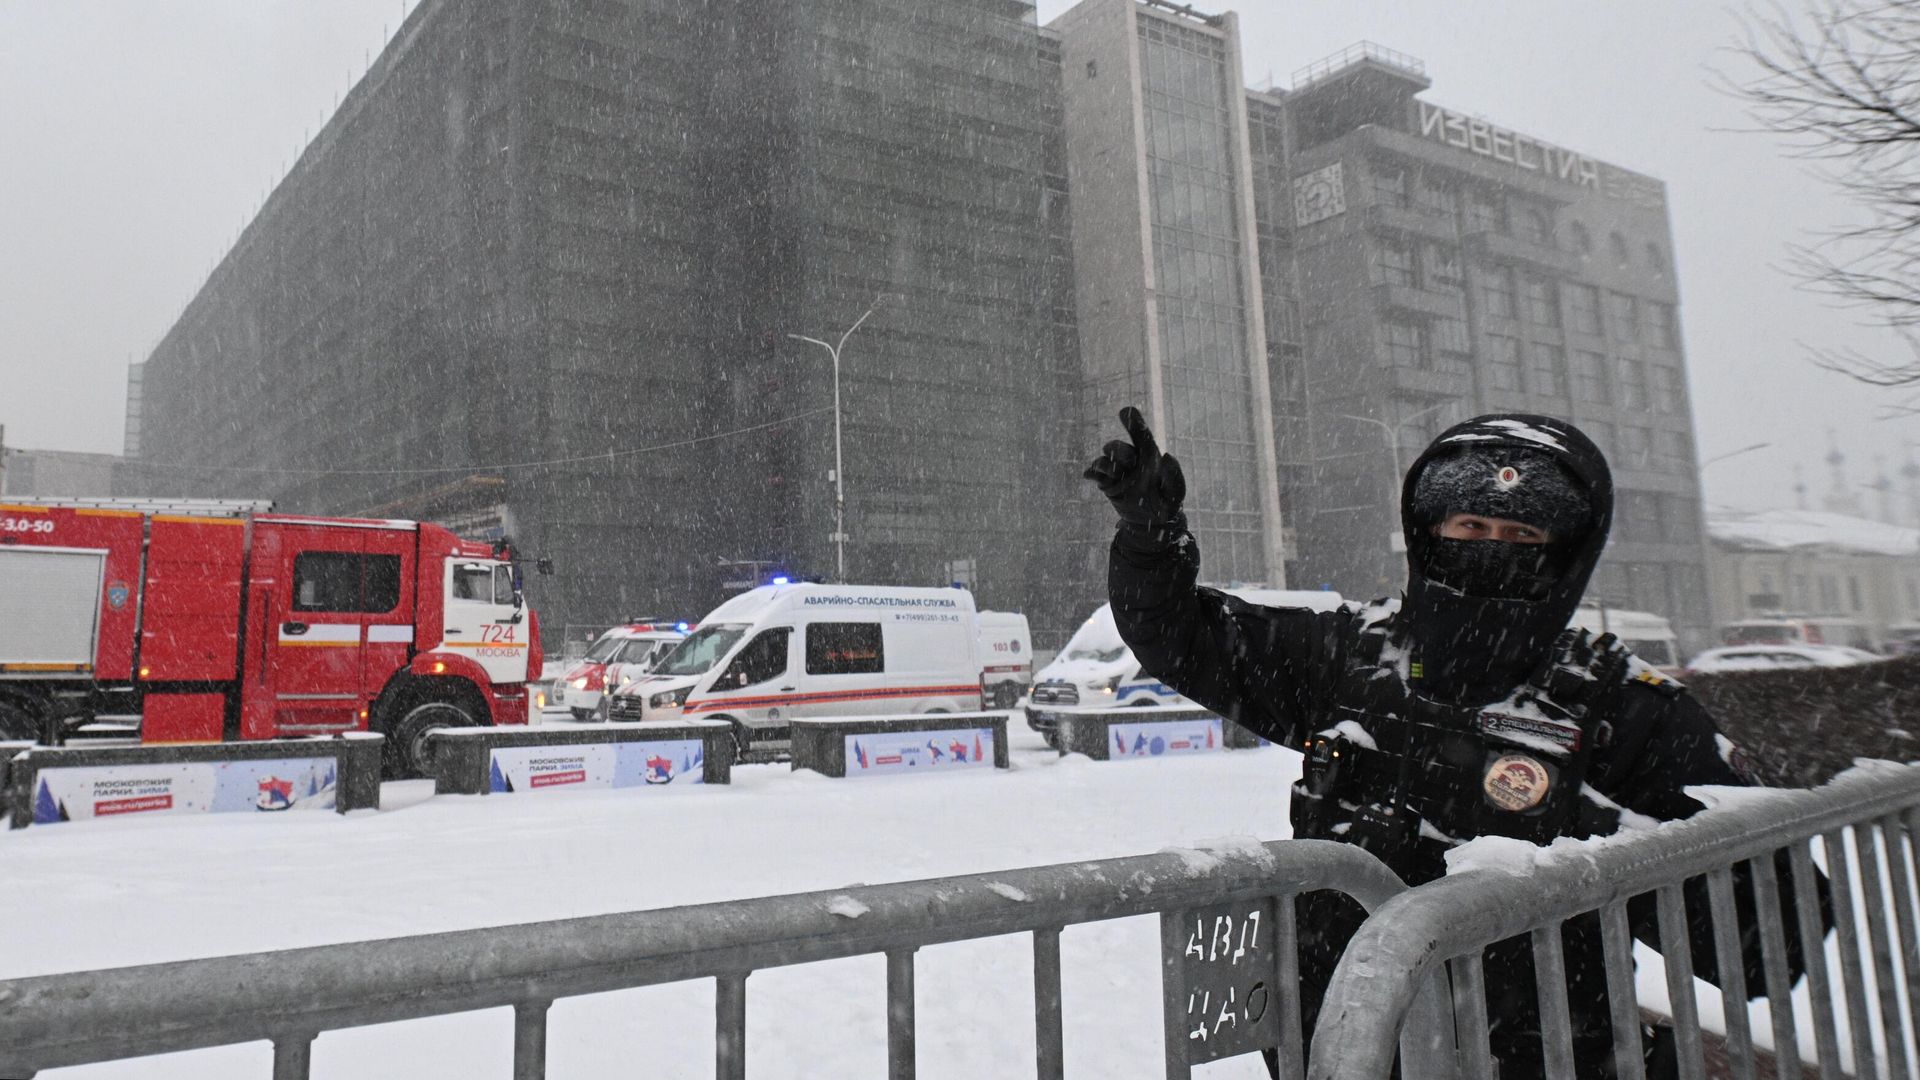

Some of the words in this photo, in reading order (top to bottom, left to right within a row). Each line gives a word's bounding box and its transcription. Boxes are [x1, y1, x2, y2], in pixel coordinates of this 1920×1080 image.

[1419, 101, 1599, 189] ИЗВЕСТИЯ
[803, 596, 922, 607] АВАРИЙНО-СПАСАТЕЛЬНАЯ
[923, 598, 957, 608] СЛУЖБА
[480, 624, 515, 643] 724
[992, 641, 1009, 652] 103
[475, 647, 521, 658] МОСКВА
[1487, 717, 1498, 729] 2
[529, 756, 585, 765] МОСКОВСКИЕ
[560, 763, 584, 771] ЗИМА
[94, 778, 173, 789] МОСКОВСКИЕ
[137, 786, 170, 795] ЗИМА
